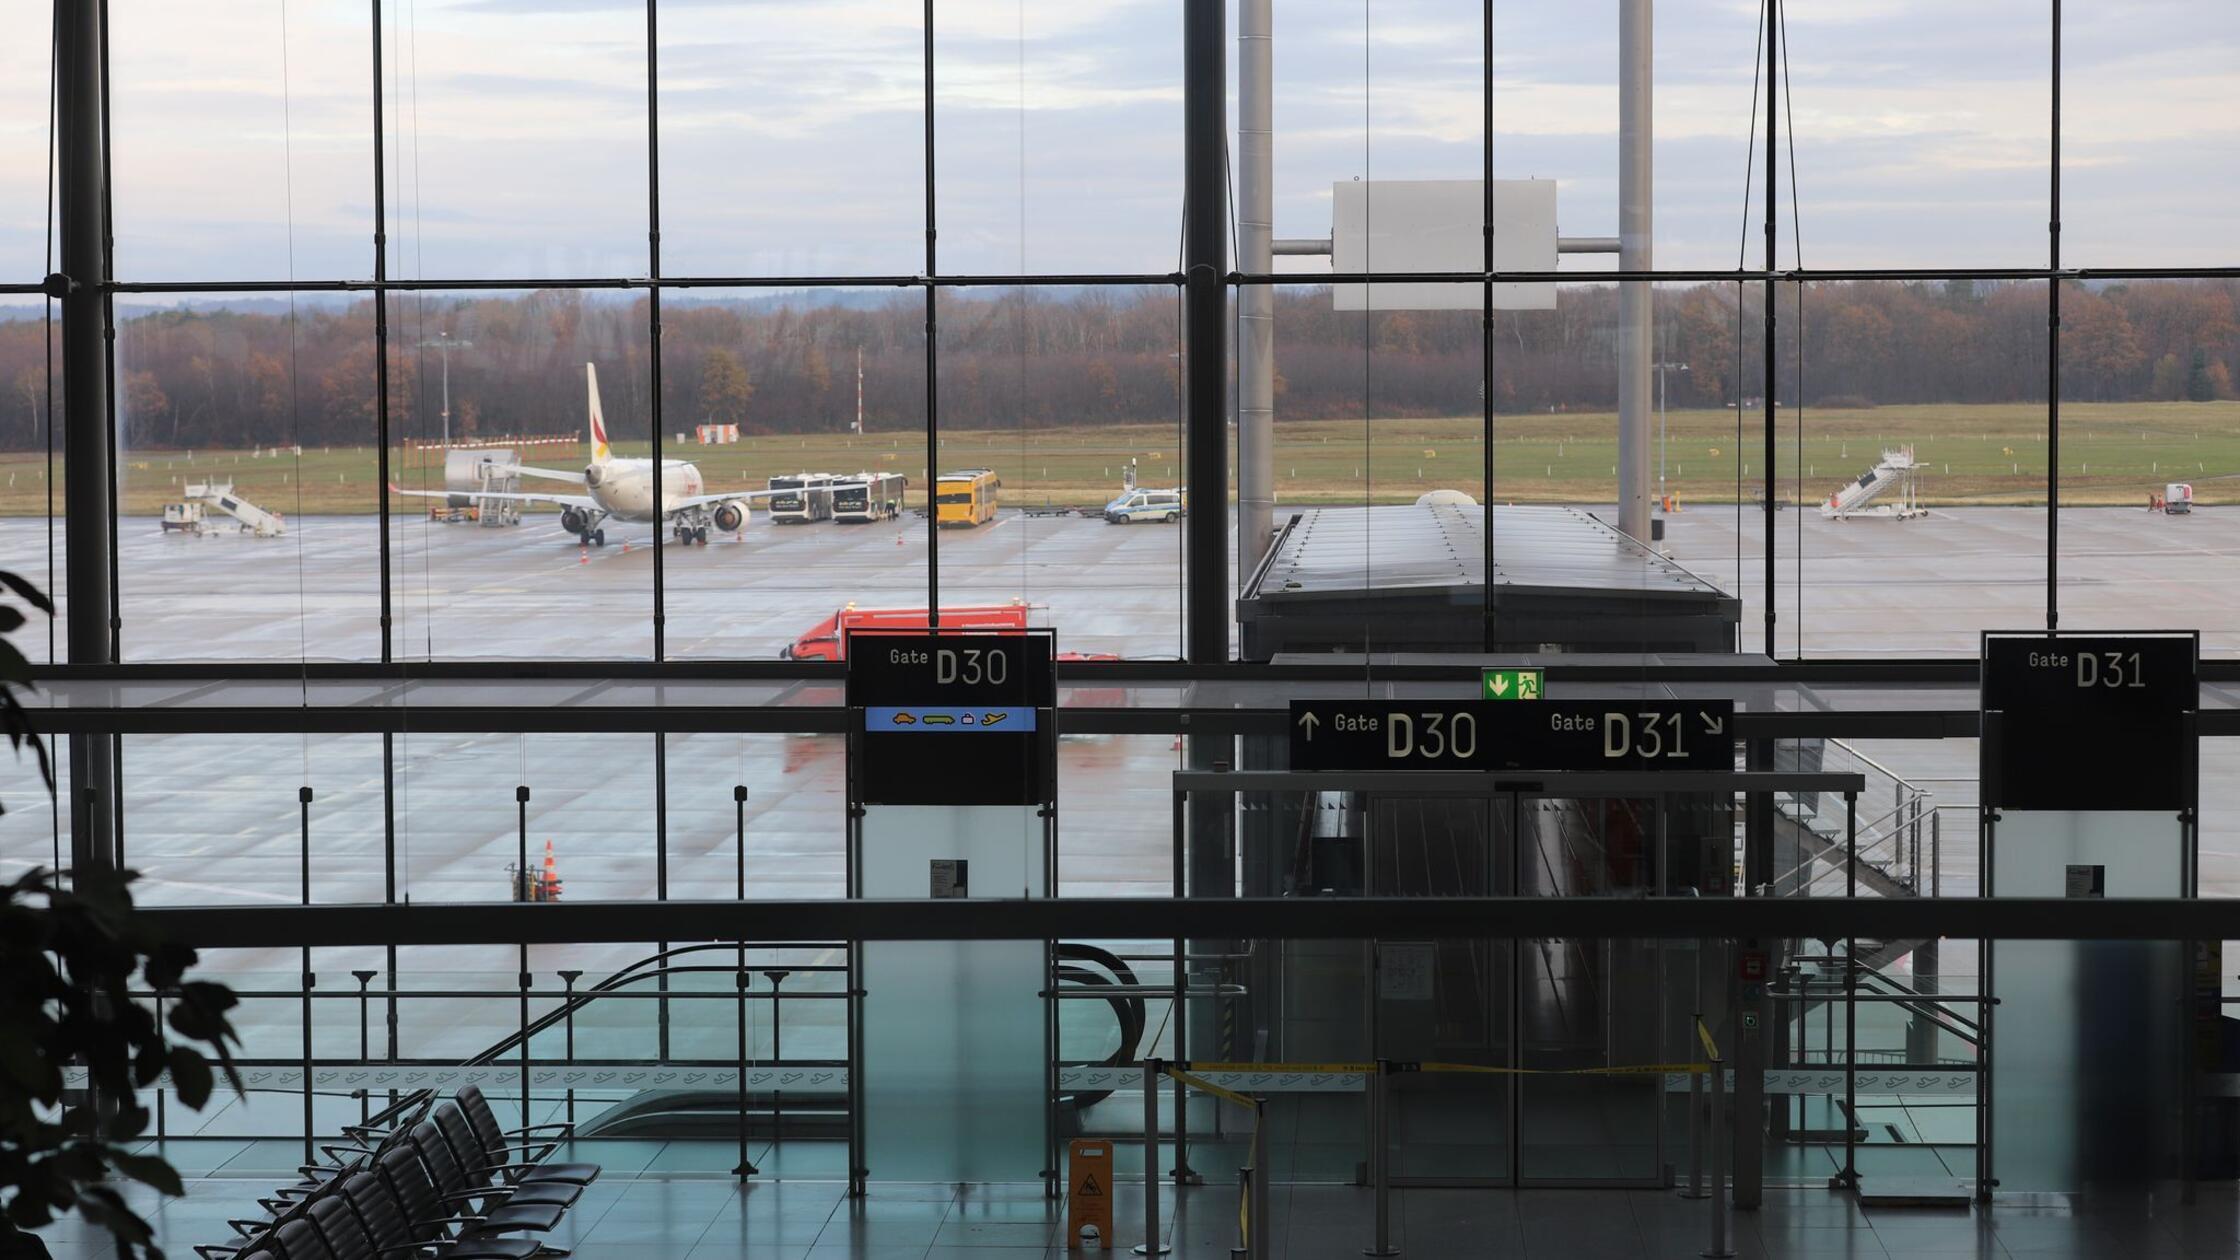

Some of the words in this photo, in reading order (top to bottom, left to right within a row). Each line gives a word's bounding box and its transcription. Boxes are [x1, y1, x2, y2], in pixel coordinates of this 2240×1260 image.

[890, 649, 928, 664] Gate
[936, 649, 1007, 685] D30
[2029, 652, 2069, 668] Gate
[2077, 652, 2146, 688] D31
[1334, 714, 1378, 732] Gate
[1387, 712, 1476, 759] D30
[1551, 713, 1595, 731] Gate
[1604, 712, 1690, 758] D31
